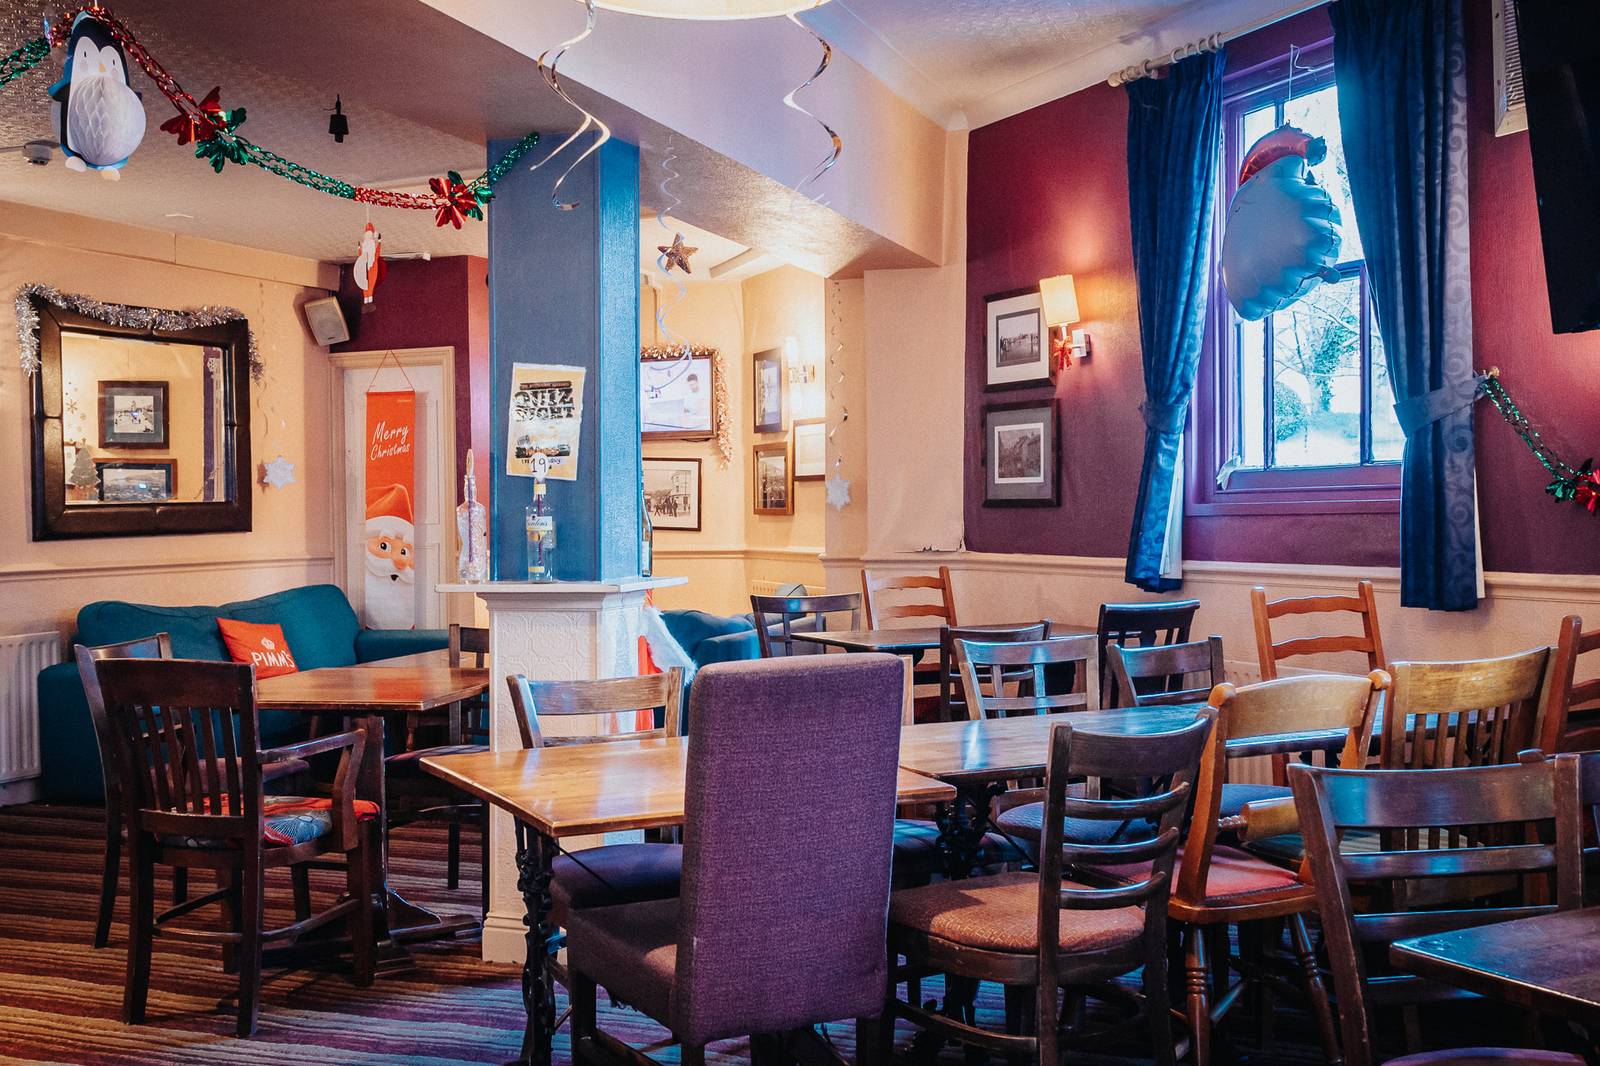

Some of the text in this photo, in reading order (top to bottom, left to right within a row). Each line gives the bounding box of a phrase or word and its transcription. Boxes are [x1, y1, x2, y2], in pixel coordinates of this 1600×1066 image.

[514, 388, 574, 407] QUIZ
[372, 421, 409, 445] Merry
[370, 443, 411, 461] Christmas
[530, 457, 546, 473] 19
[251, 650, 296, 668] PIMM'S
